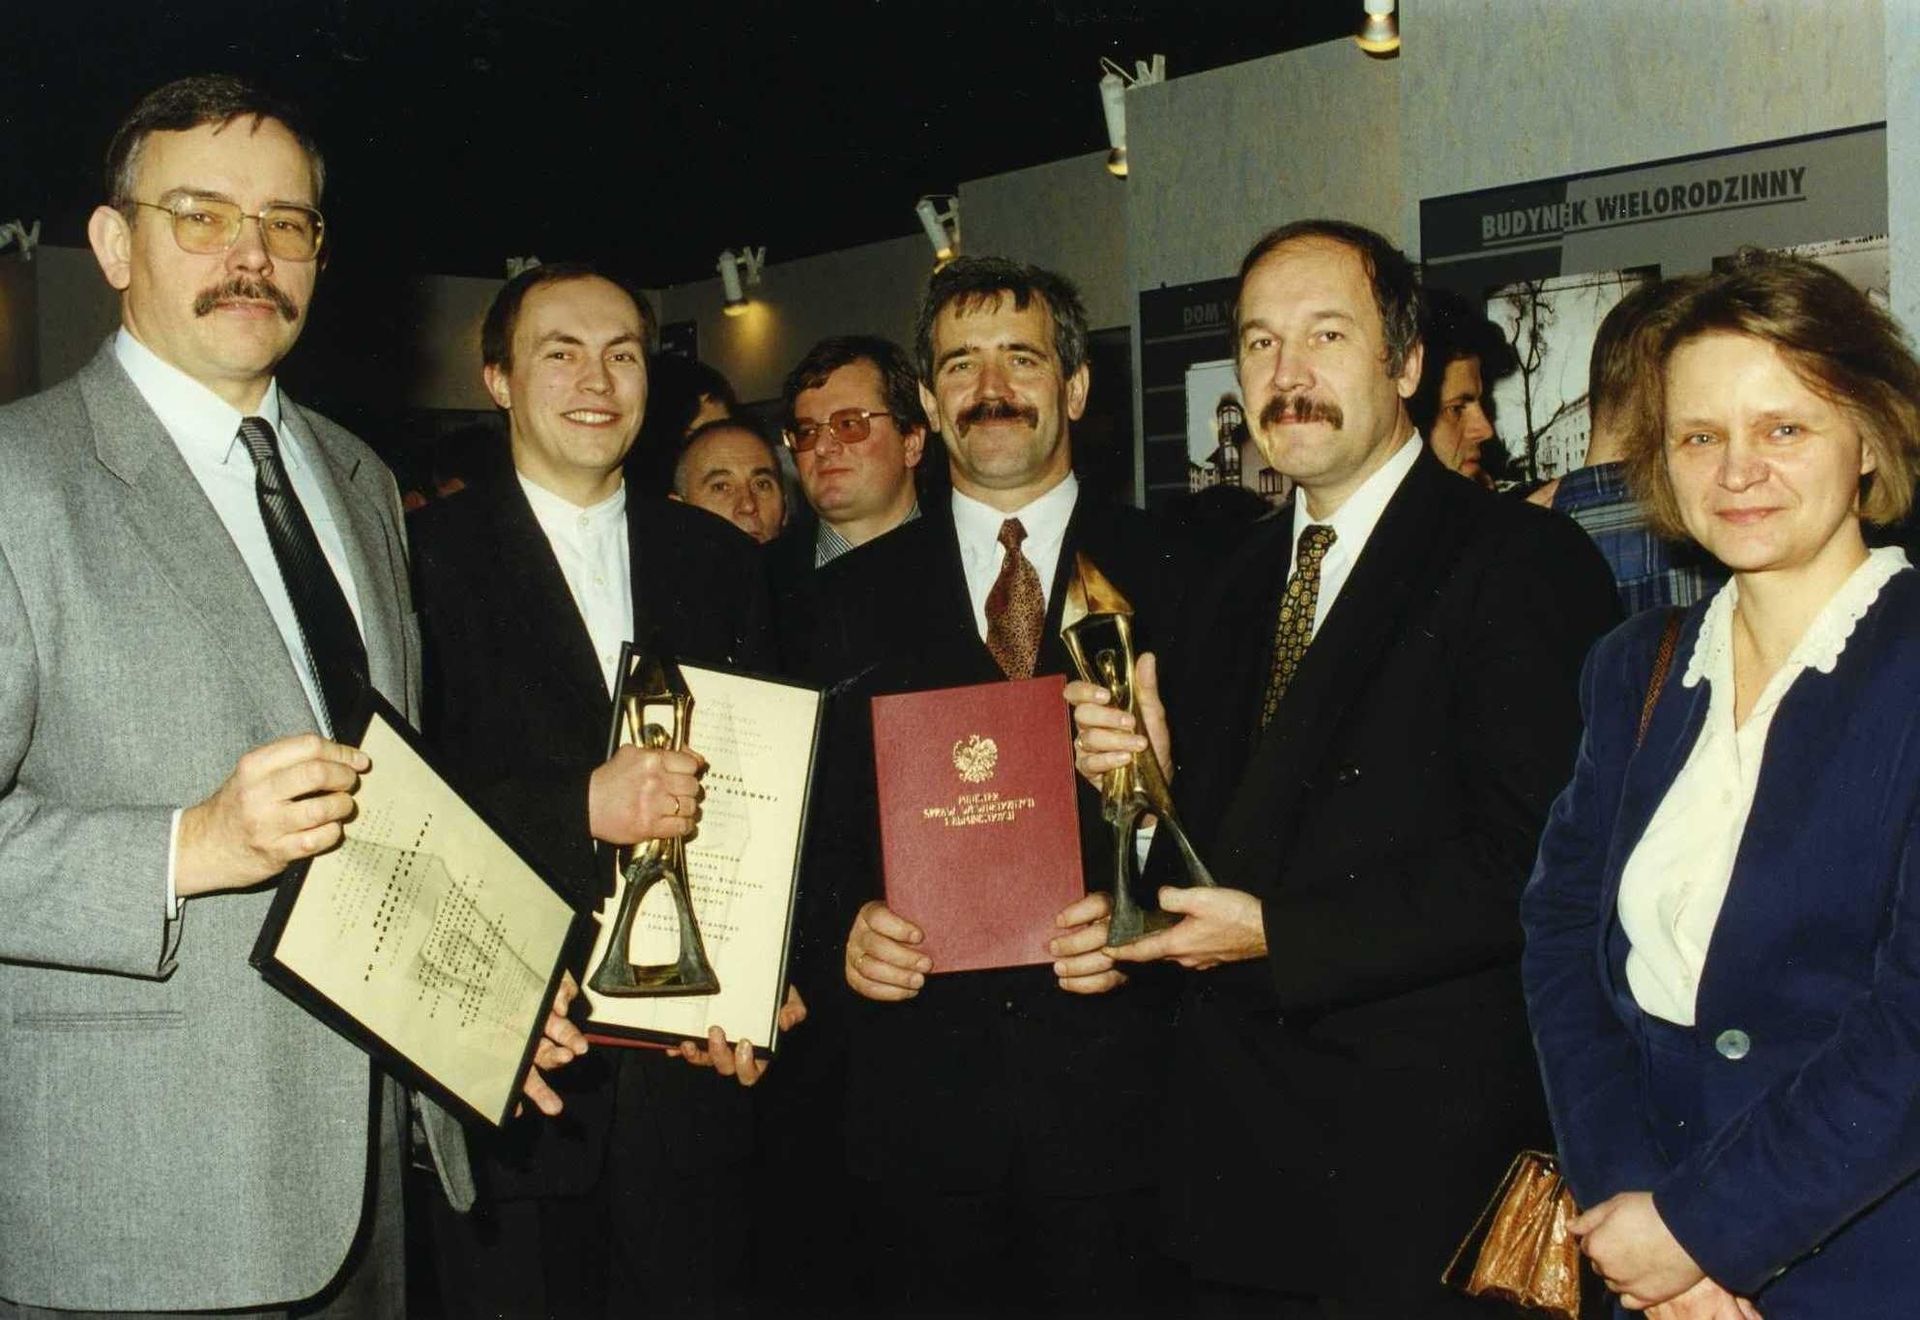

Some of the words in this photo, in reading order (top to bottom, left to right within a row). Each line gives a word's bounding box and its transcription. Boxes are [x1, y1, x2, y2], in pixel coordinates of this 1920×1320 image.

[1482, 201, 1588, 240] BUDYNEK
[1596, 167, 1807, 222] WIELORODZINNY
[1183, 303, 1220, 325] DOM
